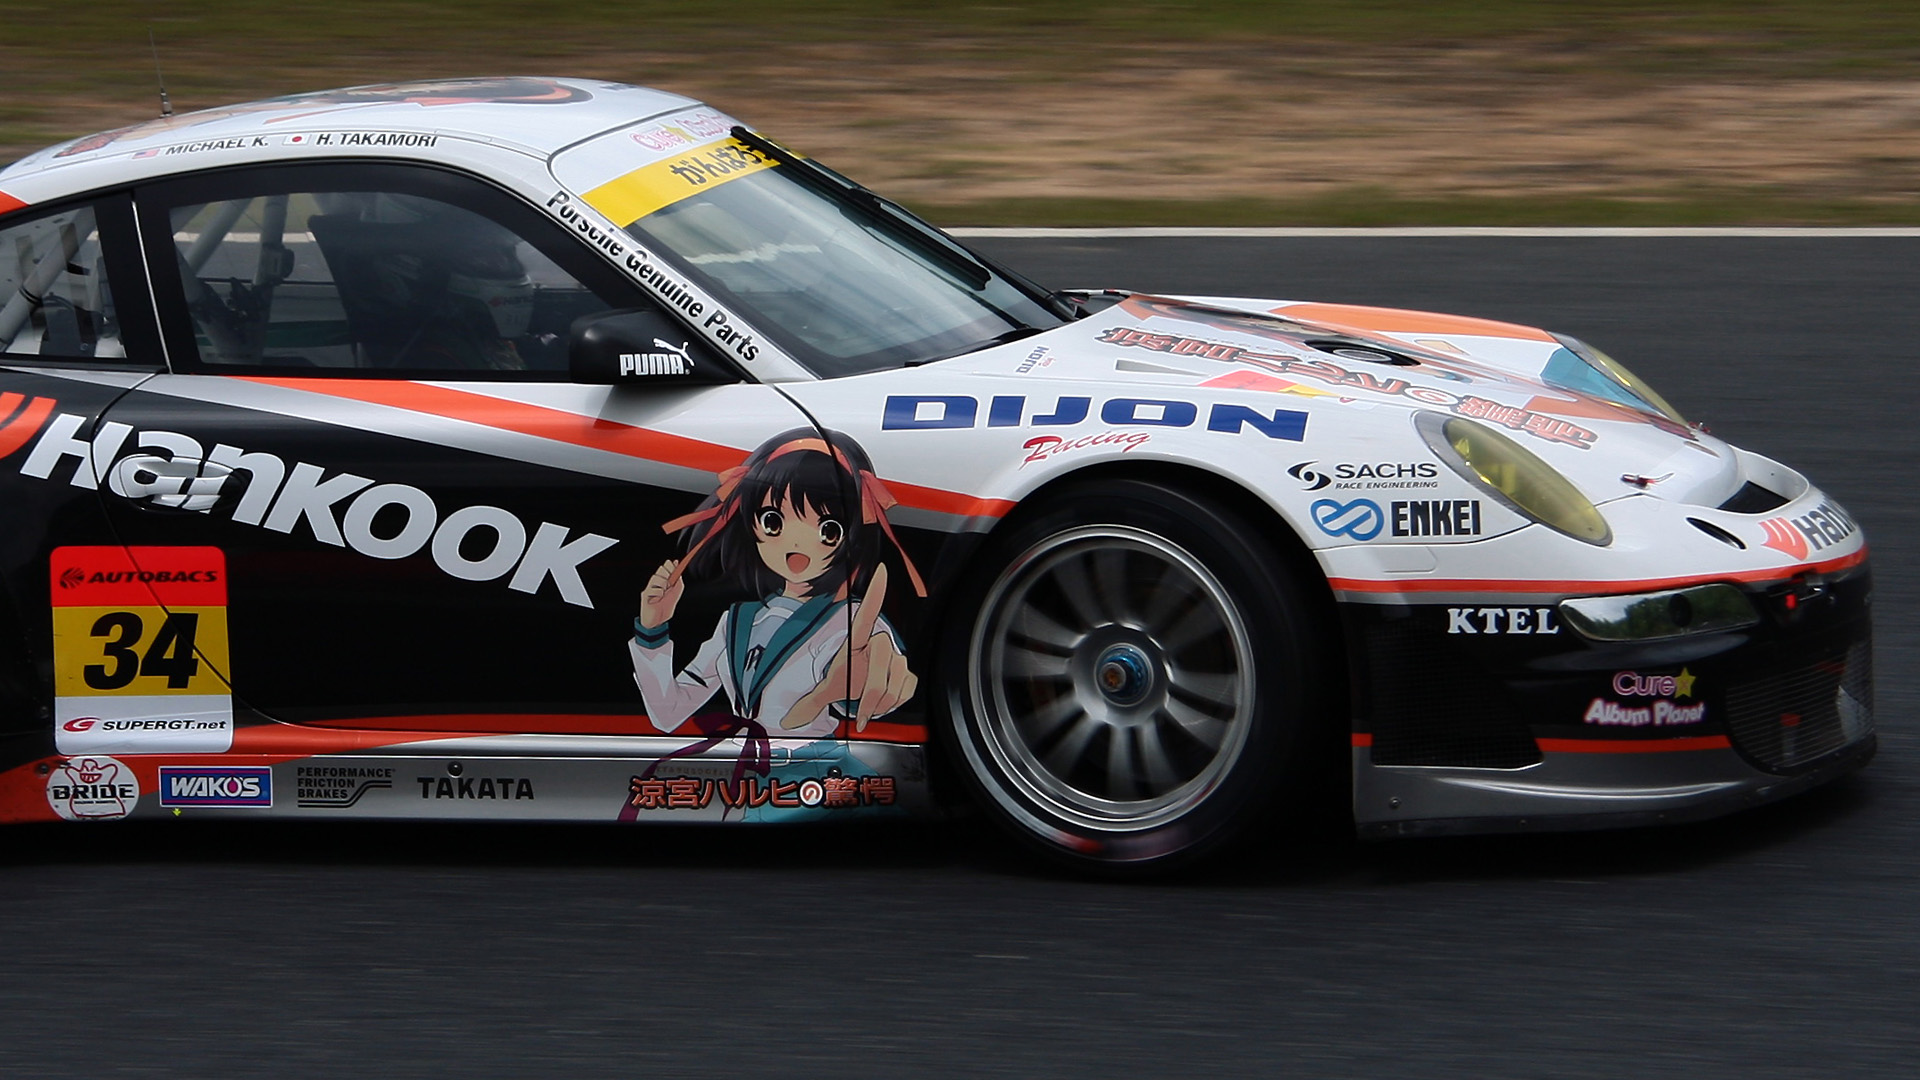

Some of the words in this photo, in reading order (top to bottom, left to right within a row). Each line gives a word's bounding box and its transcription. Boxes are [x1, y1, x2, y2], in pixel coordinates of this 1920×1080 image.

[165, 138, 247, 156] MICHAEL
[251, 135, 270, 148] K.
[316, 133, 335, 146] H.
[340, 132, 438, 148] TAKAMORI
[625, 249, 704, 318] Genuine
[703, 309, 761, 362] Parts
[619, 353, 686, 377] PUMA
[881, 395, 1310, 443] DIJON
[1018, 430, 1151, 470] Racing
[1335, 462, 1438, 479] SACHS
[1335, 481, 1363, 490] RACE
[1366, 481, 1439, 490] ENGINEERING
[1391, 500, 1481, 537] ENKEI
[88, 570, 218, 584] AUTOBACS
[1447, 607, 1560, 635] KTEL
[83, 611, 199, 691] 34
[1612, 670, 1678, 697] Cure
[1584, 698, 1650, 725] Album
[1653, 699, 1705, 725] Planet
[102, 720, 227, 731] SUPERGT.net
[297, 766, 393, 778] PERFORMANCE
[297, 778, 356, 788] FRICTION
[52, 785, 136, 800] BRIDE
[297, 788, 348, 799] BRAKES
[416, 777, 535, 800] TAKATA
[629, 775, 899, 809] 涼宮ハルヒの驚愕
